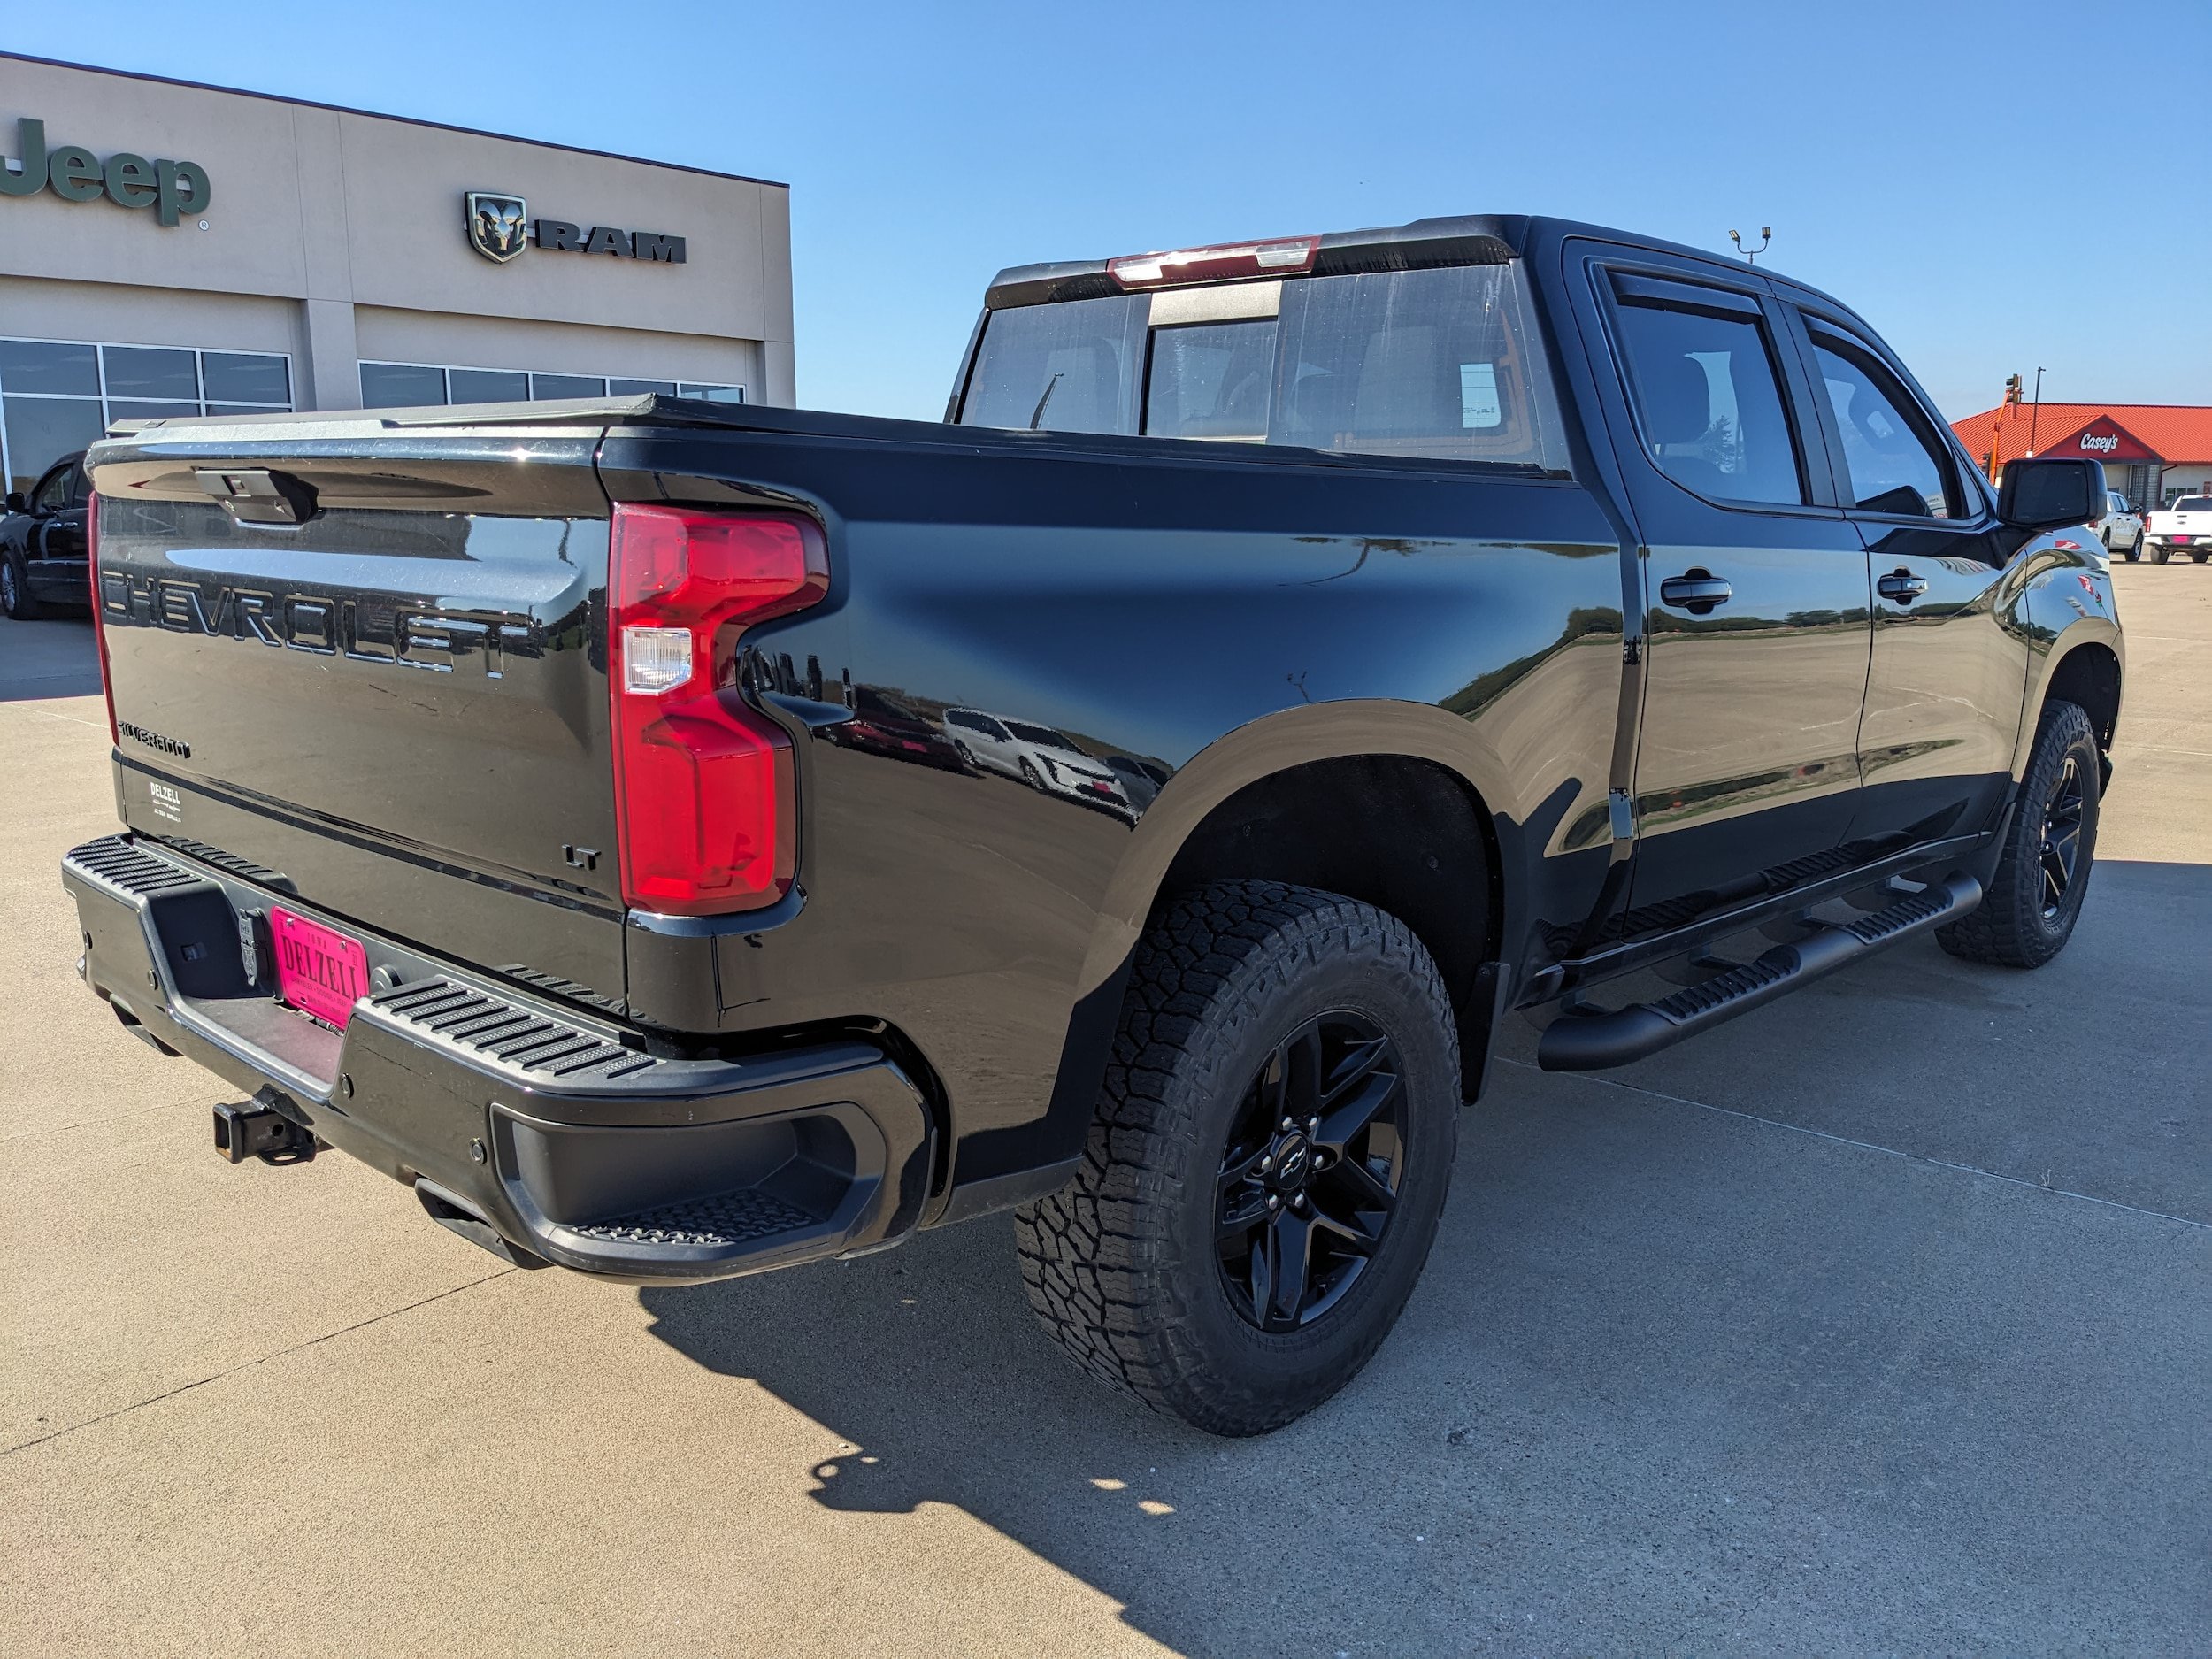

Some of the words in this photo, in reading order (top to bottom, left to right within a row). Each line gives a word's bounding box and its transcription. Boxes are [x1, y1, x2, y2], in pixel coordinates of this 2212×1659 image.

[0, 117, 211, 227] Jeep
[534, 219, 687, 265] RAM
[2080, 433, 2119, 454] Casey's
[102, 571, 534, 680] CHEVROLET
[118, 721, 191, 759] SILVERADO
[150, 781, 181, 805] DELZELL
[562, 844, 602, 871] LT
